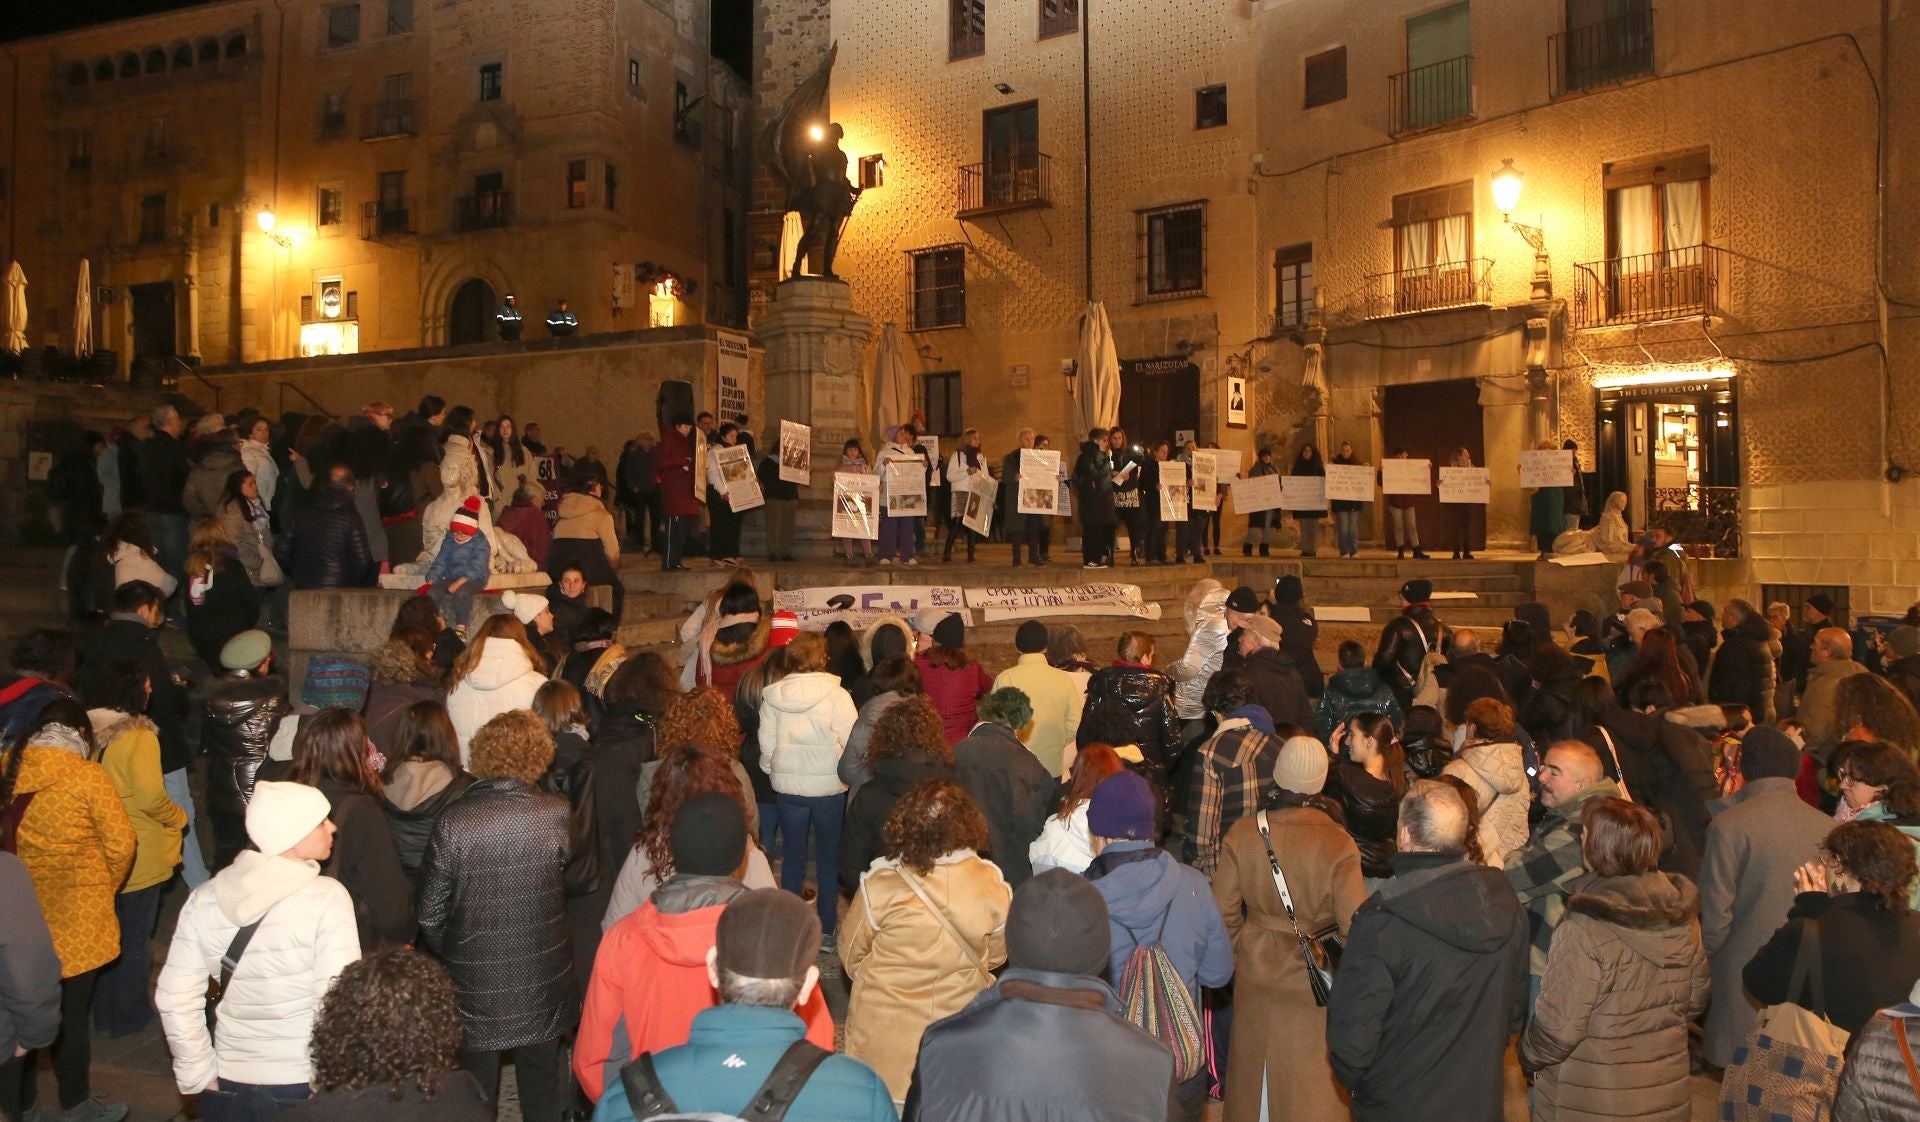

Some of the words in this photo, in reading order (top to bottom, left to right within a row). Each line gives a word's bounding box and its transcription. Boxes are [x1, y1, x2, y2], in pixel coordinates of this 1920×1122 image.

[1145, 360, 1189, 370] NARIZOTAS
[1640, 383, 1709, 395] OLPHACTORY
[1023, 595, 1063, 607] LUCHAN
